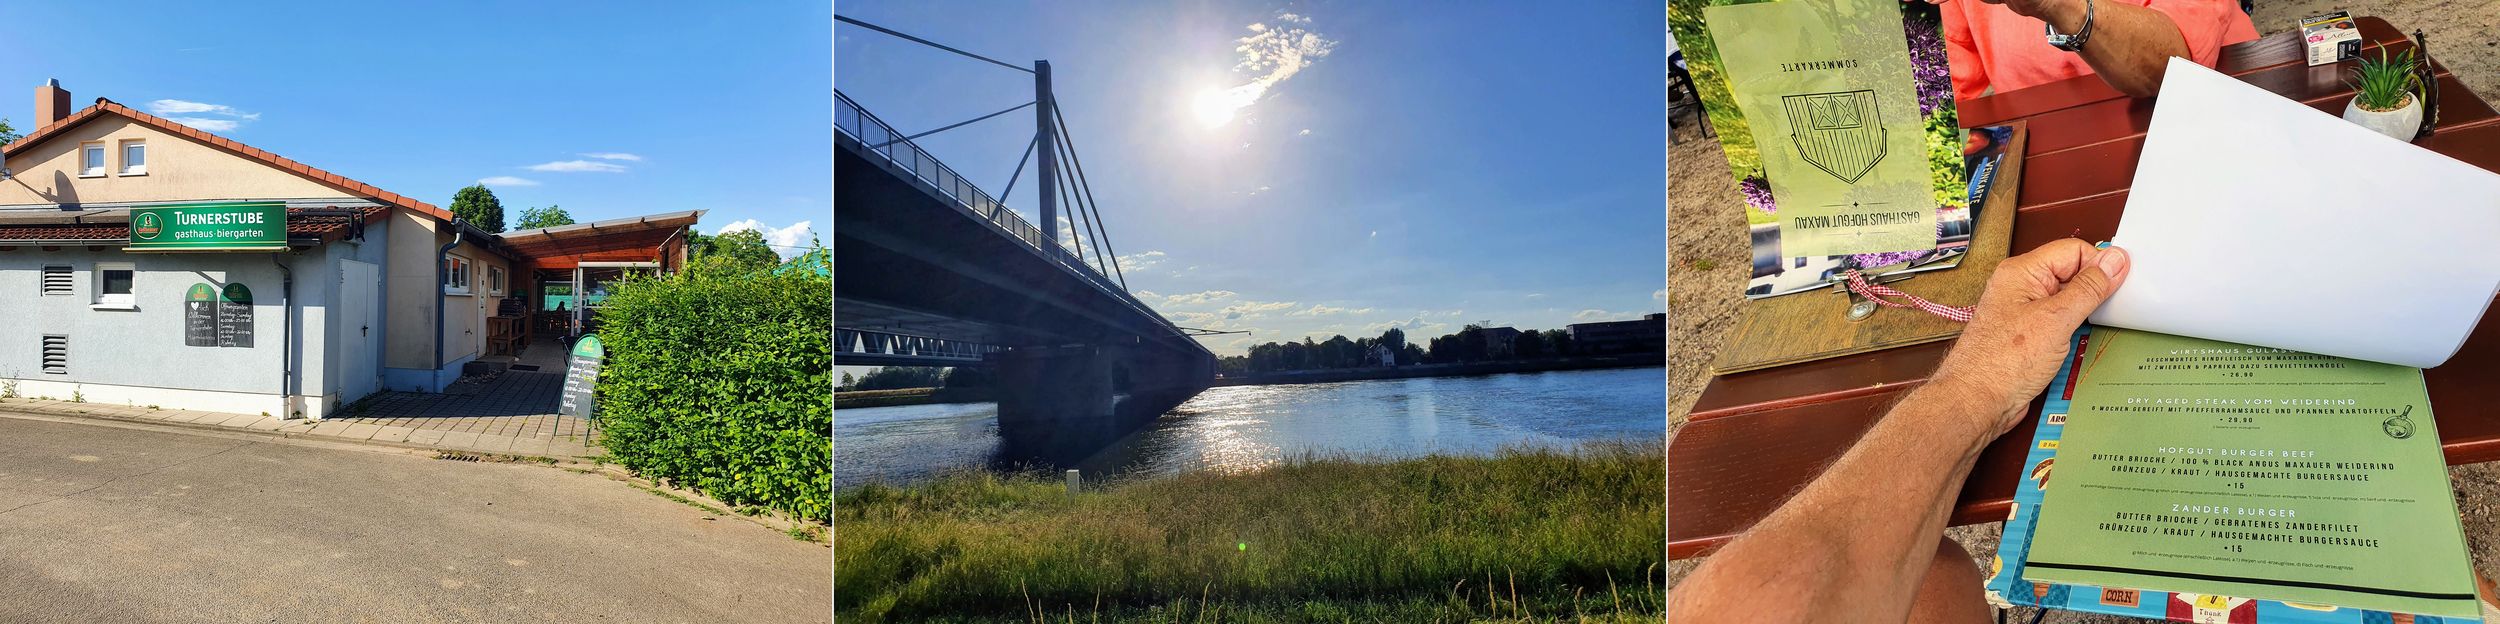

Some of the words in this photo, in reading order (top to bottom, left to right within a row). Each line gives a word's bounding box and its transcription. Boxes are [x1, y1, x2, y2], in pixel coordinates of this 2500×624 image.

[1781, 59, 1858, 72] SOMMERKARTE
[174, 212, 264, 225] TURNERSTUBE
[1794, 216, 1830, 229] MAXAU
[1833, 213, 1867, 227] HOFGUT
[1871, 211, 1920, 225] GASTHAUS
[2222, 449, 2274, 457] BURGER
[2092, 454, 2124, 462] BUTTER
[2128, 455, 2166, 463] BRIOCHE
[2336, 462, 2395, 470] WEIDERIND
[2111, 465, 2156, 474] GRÜNZEUG
[2215, 470, 2291, 480] HAUSGEMACHTE
[2297, 473, 2369, 482] BURGERSAUCE
[2173, 504, 2229, 514] ZANDER
[2238, 507, 2295, 517] BURGER
[2116, 512, 2152, 521] BUTTER
[2157, 515, 2198, 524] BRIOCHE
[2215, 519, 2280, 528] GEBRATENES
[2286, 522, 2358, 532] ZANDERFILET
[2099, 523, 2148, 534] GRÜNZEUG
[2164, 528, 2195, 536] KRAUT
[2211, 531, 2293, 542] HAUSGEMACHTE
[2300, 535, 2378, 548] BURGERSAUCE
[2106, 590, 2133, 603] CORN
